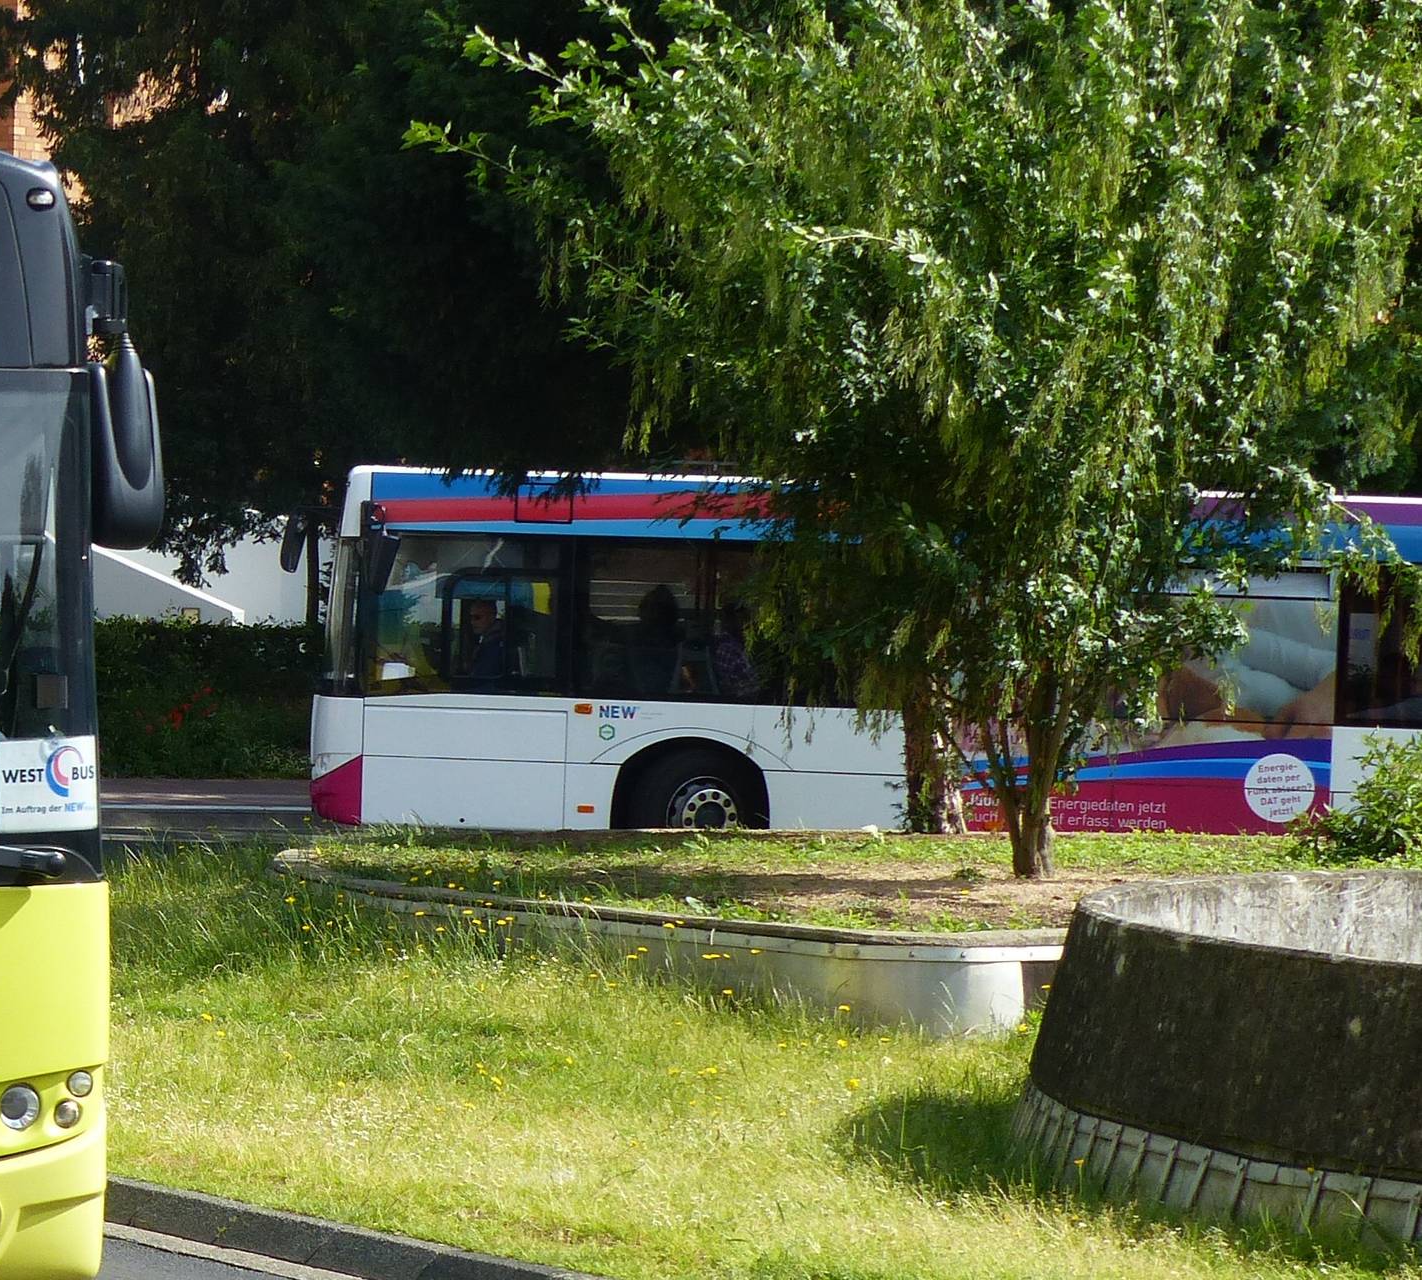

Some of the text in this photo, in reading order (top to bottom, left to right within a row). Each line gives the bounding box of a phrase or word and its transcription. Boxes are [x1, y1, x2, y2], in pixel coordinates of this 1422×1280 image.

[599, 705, 636, 719] NEW
[2, 766, 94, 783] WEST BUS
[1257, 775, 1300, 784] daten per
[1049, 797, 1166, 816] Energiedaten jetzt
[1280, 796, 1301, 806] geht
[1, 806, 13, 815] Im
[15, 804, 46, 815] Auftrag
[48, 804, 62, 813] der
[65, 802, 84, 812] NEW
[1118, 816, 1167, 829] werden
